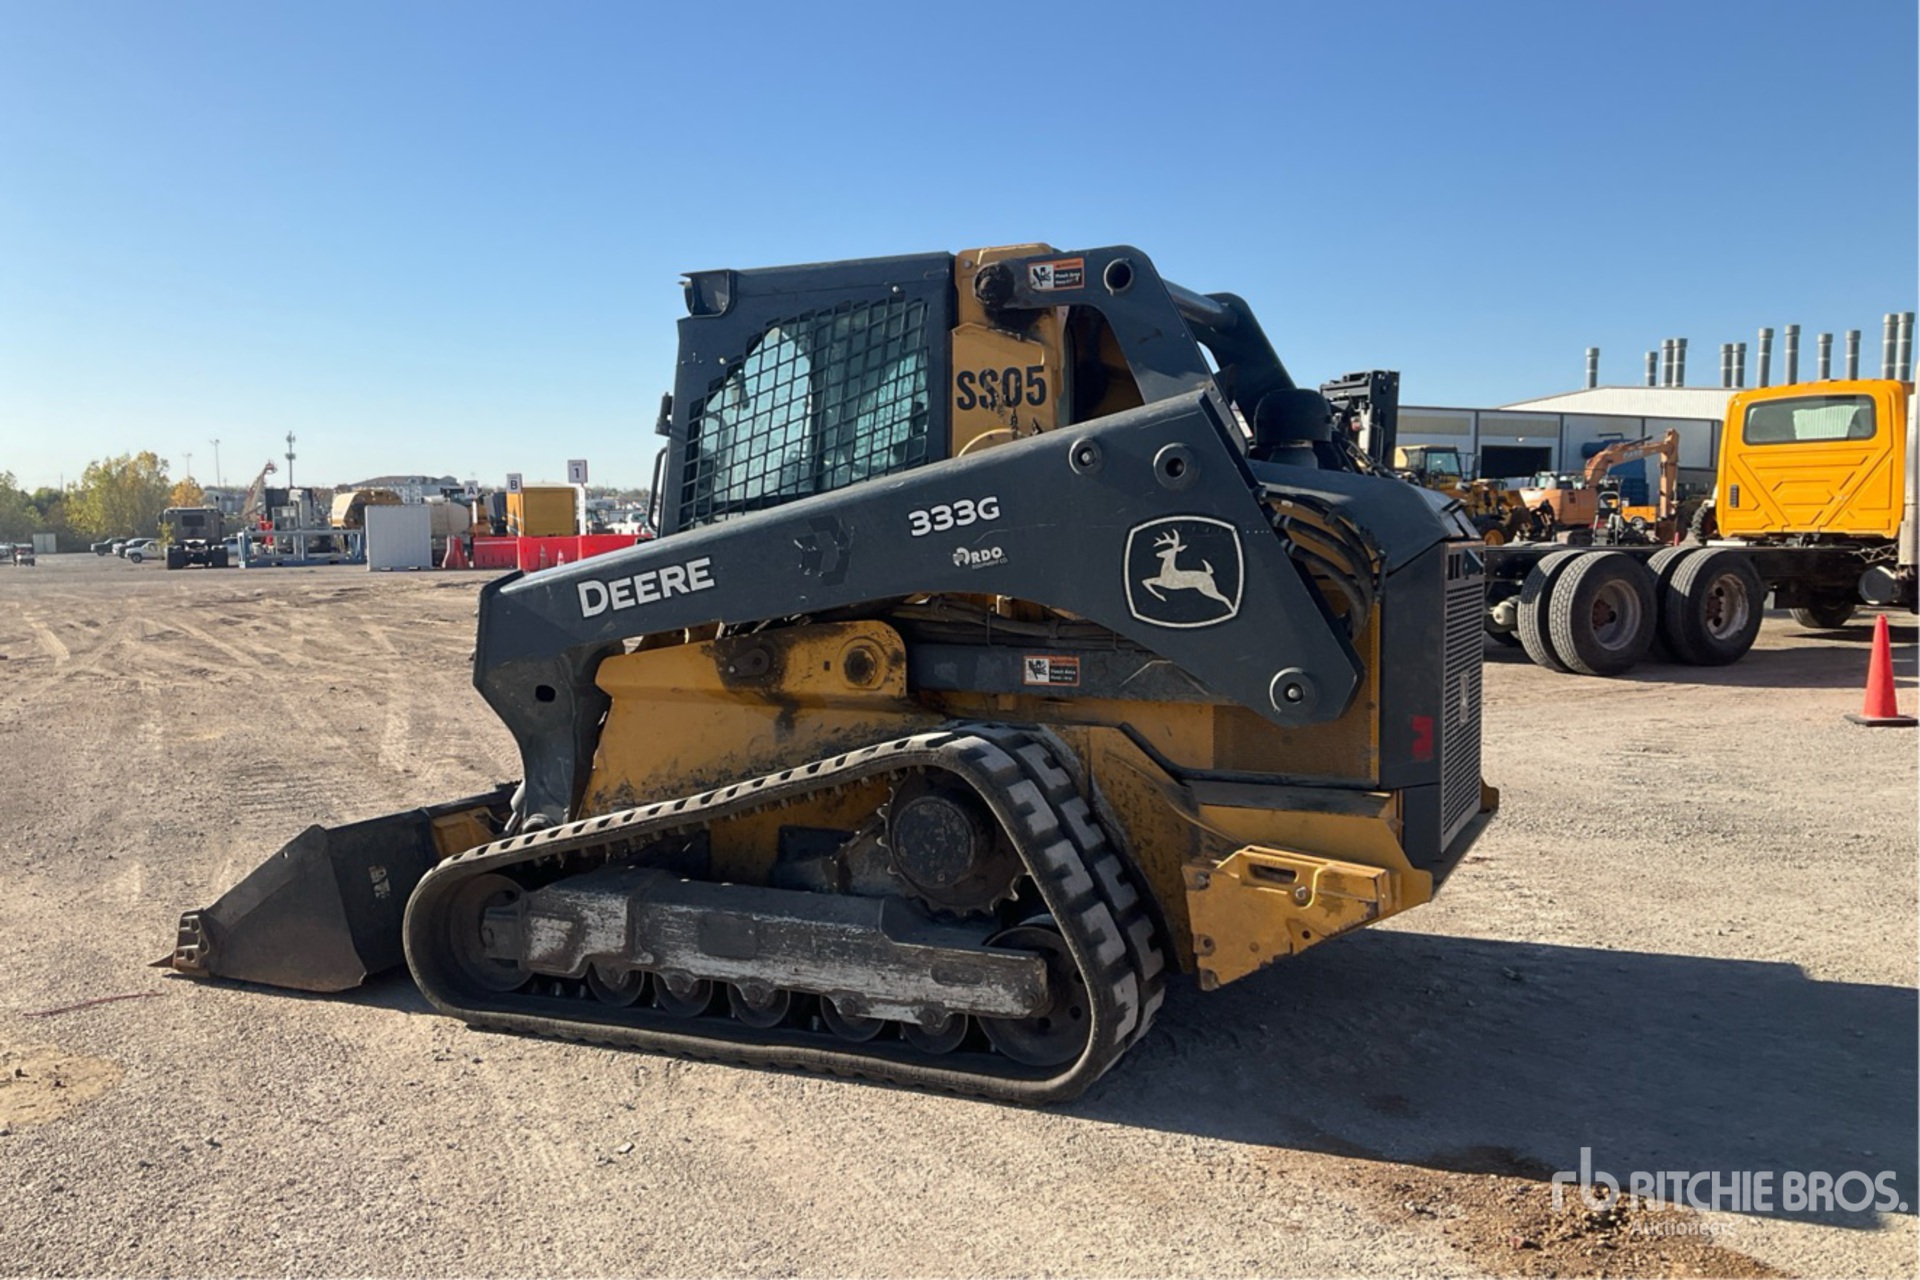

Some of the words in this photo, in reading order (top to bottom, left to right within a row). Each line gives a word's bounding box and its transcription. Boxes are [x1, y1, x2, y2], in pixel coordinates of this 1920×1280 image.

[956, 365, 1047, 411] SS05
[510, 480, 518, 490] B
[573, 467, 580, 479] 1
[467, 486, 476, 496] A
[908, 496, 1001, 537] 333G
[577, 557, 715, 618] DEERE
